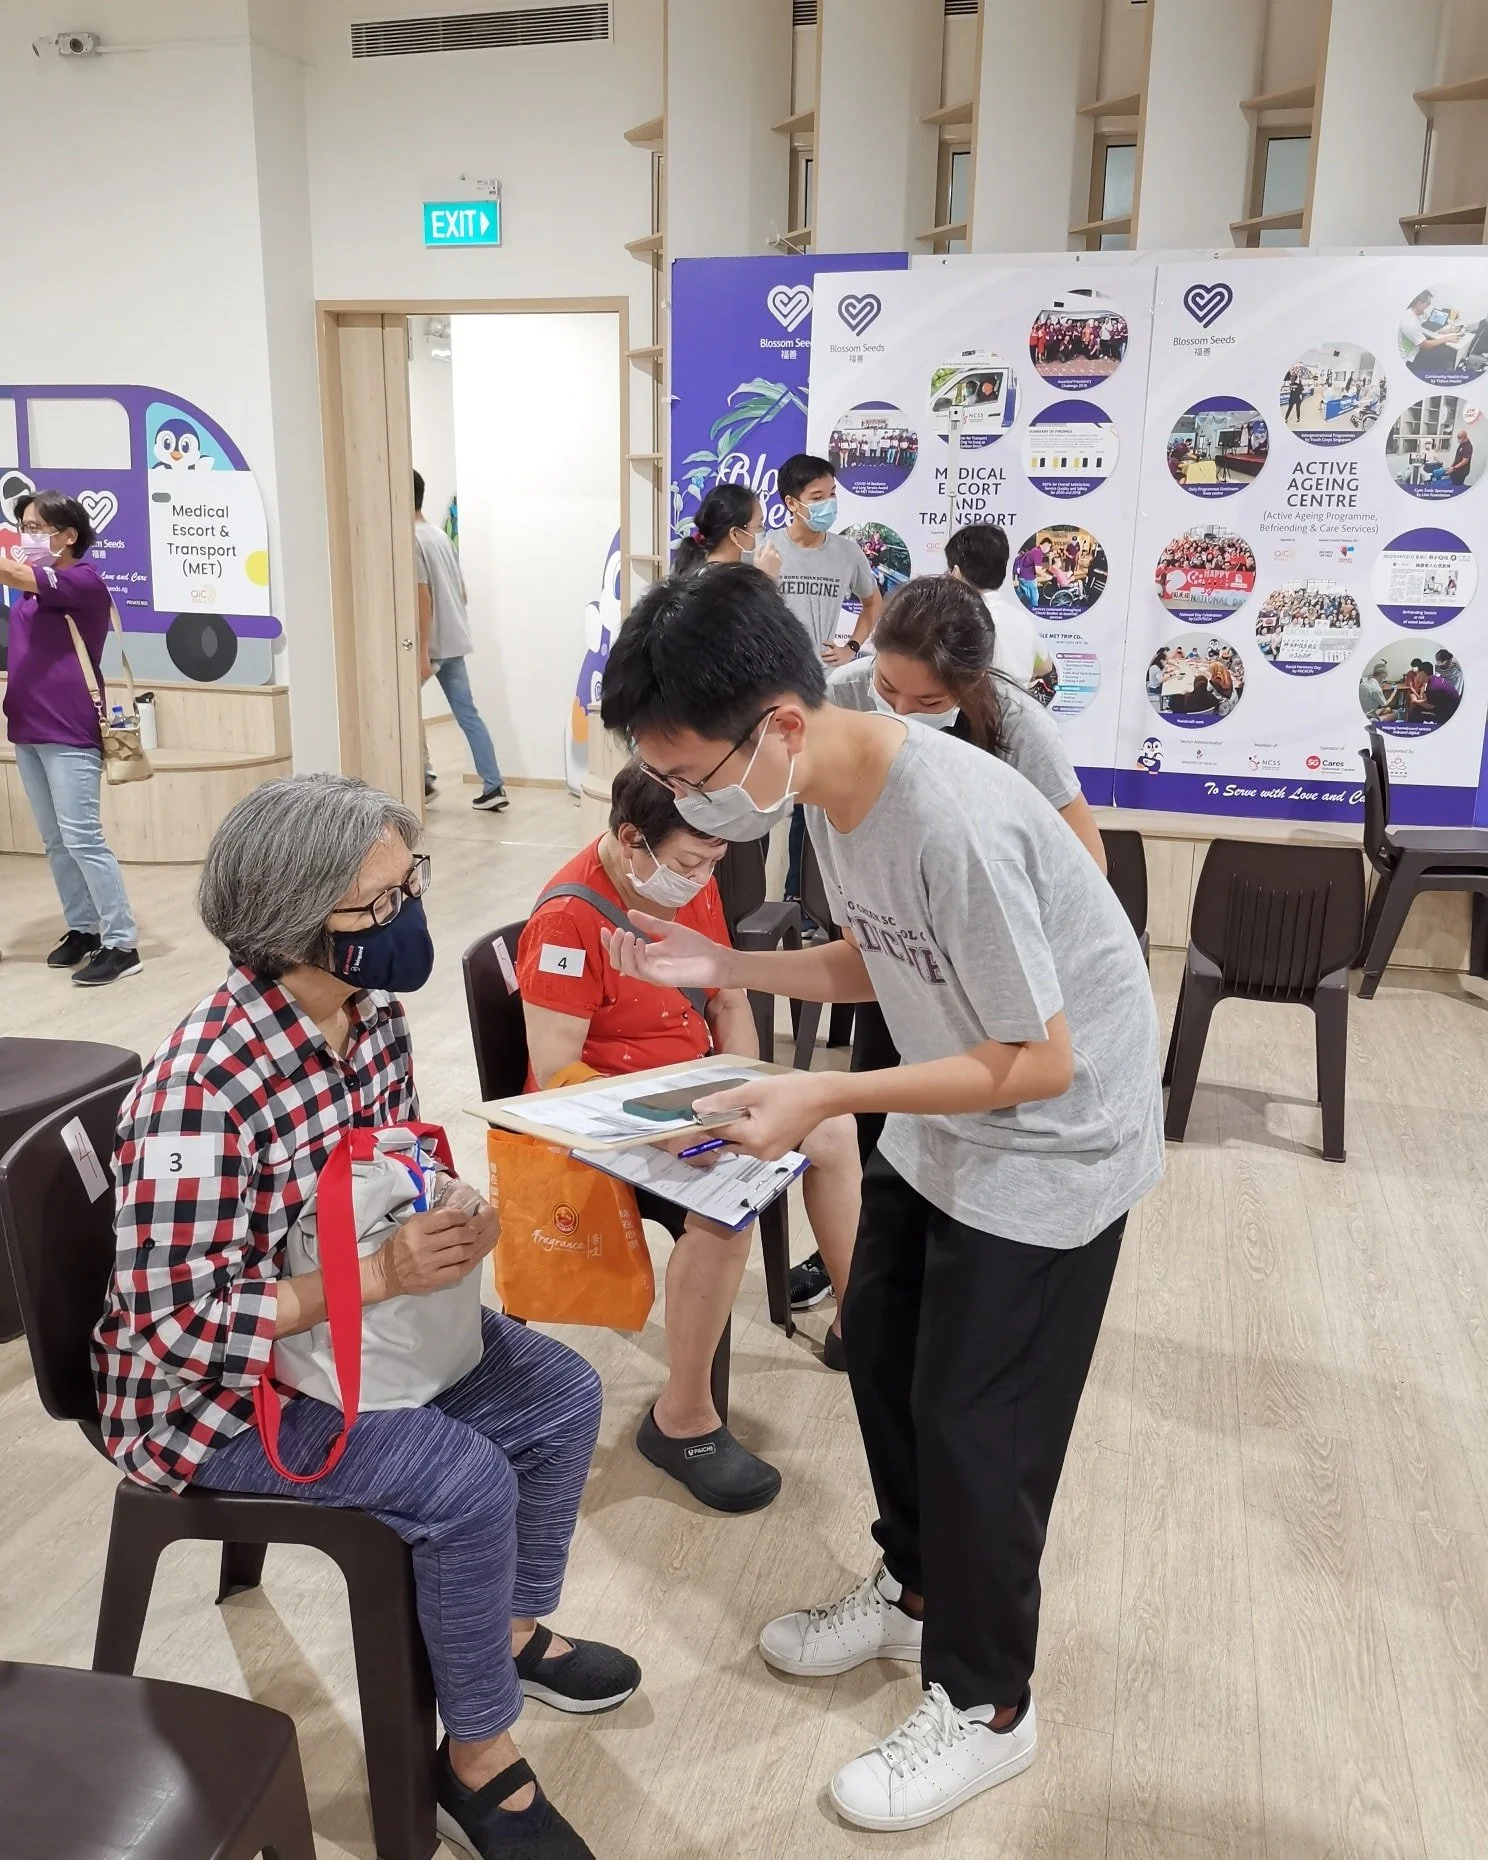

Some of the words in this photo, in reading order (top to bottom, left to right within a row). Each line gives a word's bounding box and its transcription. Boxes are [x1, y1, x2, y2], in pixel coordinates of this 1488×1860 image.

[431, 210, 476, 238] EXIT
[760, 338, 793, 348] Blossom
[795, 338, 811, 348] See
[1173, 336, 1208, 346] Blossom
[1210, 334, 1235, 344] Seeds
[830, 344, 860, 352] Blossom
[862, 344, 885, 352] Seeds
[935, 468, 1006, 480] MDICAL
[1292, 461, 1358, 475] ACTIVE
[938, 482, 1002, 496] ECORT
[1287, 478, 1360, 492] AGEING
[1287, 494, 1358, 508] CENTRE
[172, 504, 229, 518] Medical
[1263, 510, 1292, 522] (Active
[1294, 512, 1324, 522] Ageing
[1326, 512, 1378, 522] Programme,
[172, 524, 216, 536] Escort
[220, 525, 230, 538] &
[1259, 524, 1308, 534] Befriending
[1310, 524, 1317, 532] &
[1320, 524, 1340, 533] Care
[1341, 525, 1378, 534] Services)
[104, 540, 125, 549] Seeds
[166, 542, 236, 560] Transport
[182, 559, 222, 578] (MET)
[131, 572, 148, 582] Care
[1204, 782, 1219, 795] To
[1223, 784, 1257, 797] Serve
[1260, 786, 1287, 798] with
[1289, 787, 1319, 801] Love
[1322, 790, 1346, 802] and
[1349, 790, 1365, 805] Ca
[558, 957, 567, 970] 4
[169, 1152, 183, 1172] 3
[532, 1230, 585, 1252] Fragrance
